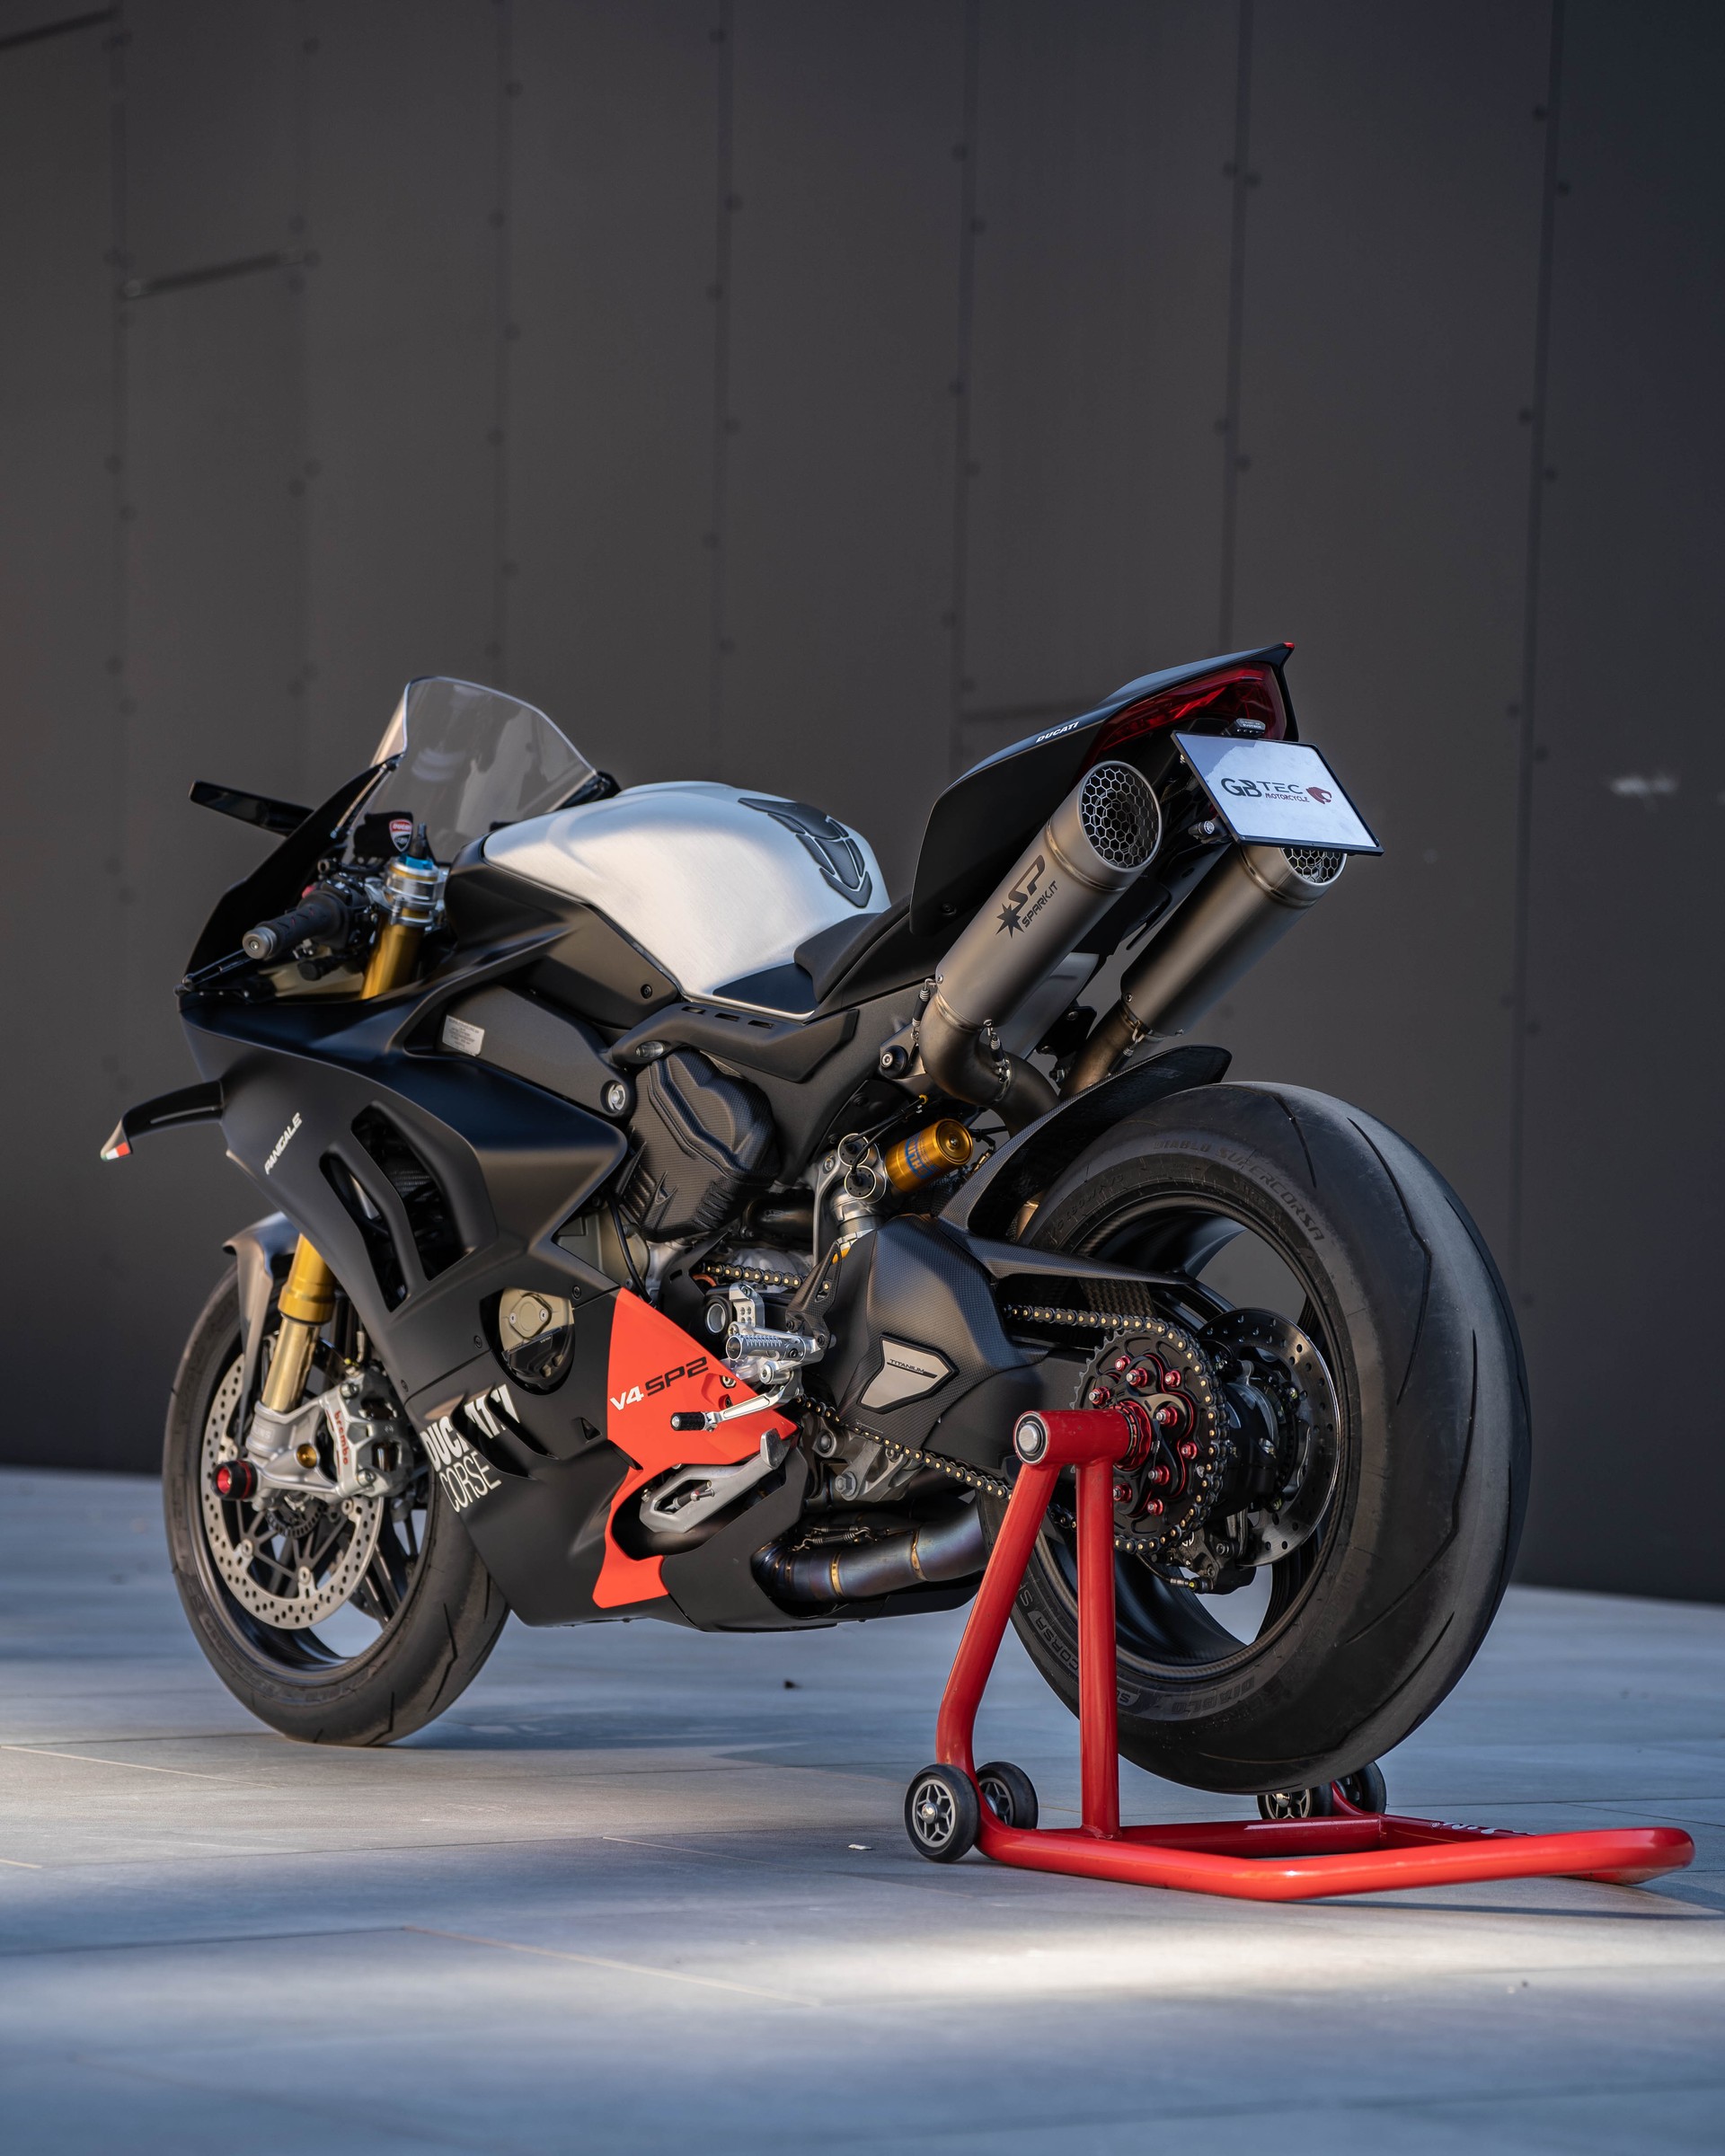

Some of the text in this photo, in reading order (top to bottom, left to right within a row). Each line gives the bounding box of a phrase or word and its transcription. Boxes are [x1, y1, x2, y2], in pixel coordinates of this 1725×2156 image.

[1035, 720, 1079, 743] DUCATI
[1264, 792, 1310, 803] MOTORCYCLE
[1022, 880, 1058, 928] SPARK.IT
[264, 1112, 303, 1175] PANIGALE
[1215, 1146, 1325, 1241] SUPERCORSA
[609, 1356, 709, 1411] V4 SP2
[889, 1358, 924, 1374] TITANIUM
[333, 1410, 349, 1465] brembo
[438, 1452, 502, 1513] CORSE
